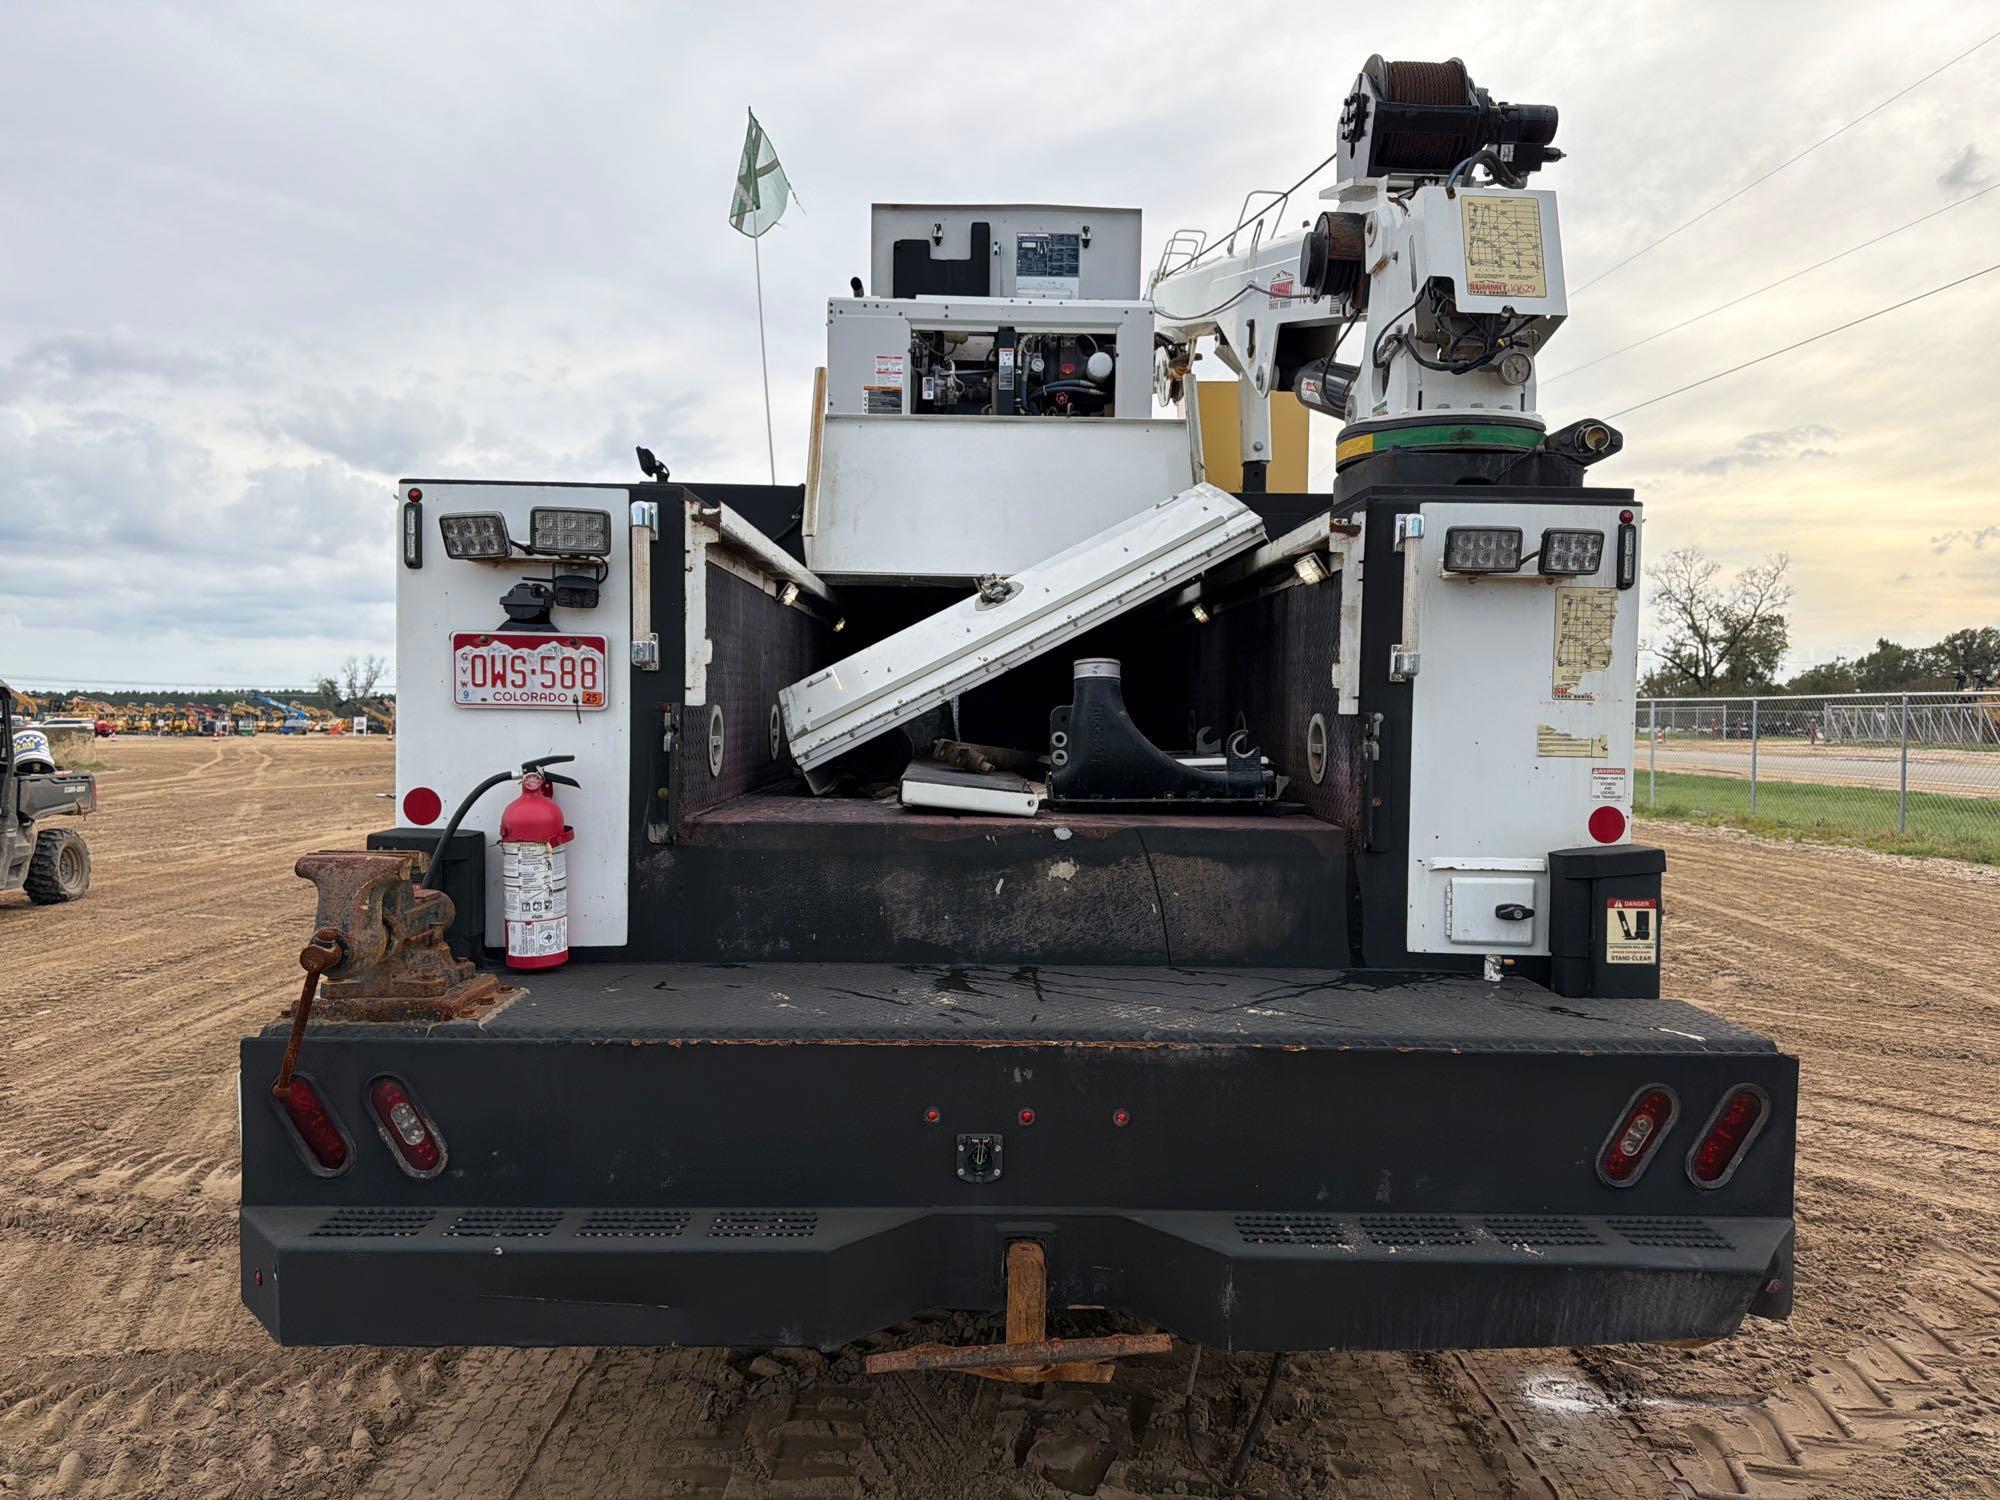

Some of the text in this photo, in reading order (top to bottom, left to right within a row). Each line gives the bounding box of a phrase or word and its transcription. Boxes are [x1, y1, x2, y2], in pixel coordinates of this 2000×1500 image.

[1469, 282, 1507, 292] SUMMIT
[493, 691, 568, 703] COLORADO
[586, 693, 598, 702] 25
